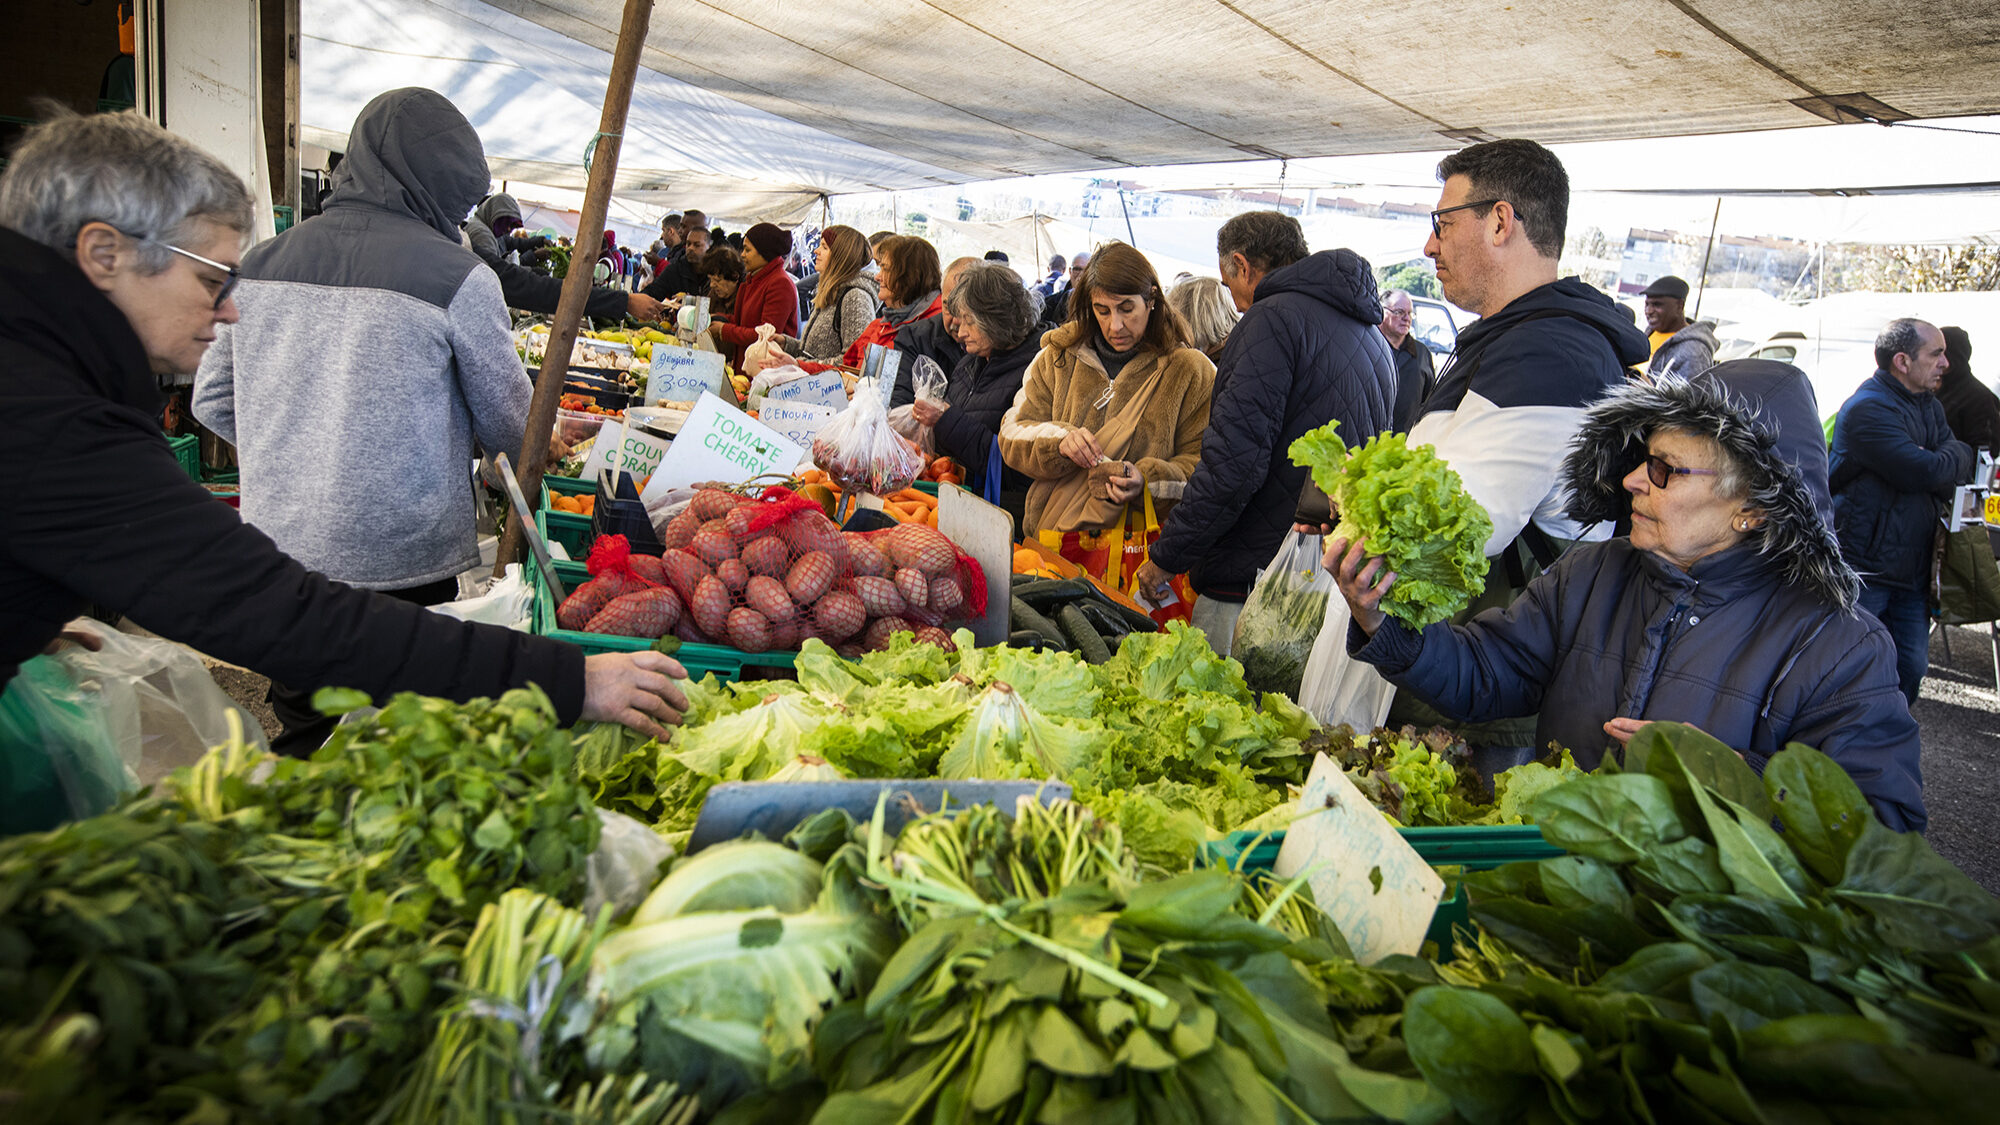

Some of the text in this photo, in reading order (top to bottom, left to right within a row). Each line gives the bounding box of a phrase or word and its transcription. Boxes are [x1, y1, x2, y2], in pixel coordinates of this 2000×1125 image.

[808, 380, 821, 391] DE
[764, 407, 813, 421] CENOURA
[712, 411, 783, 463] TOMATE
[704, 433, 770, 476] CHERRY
